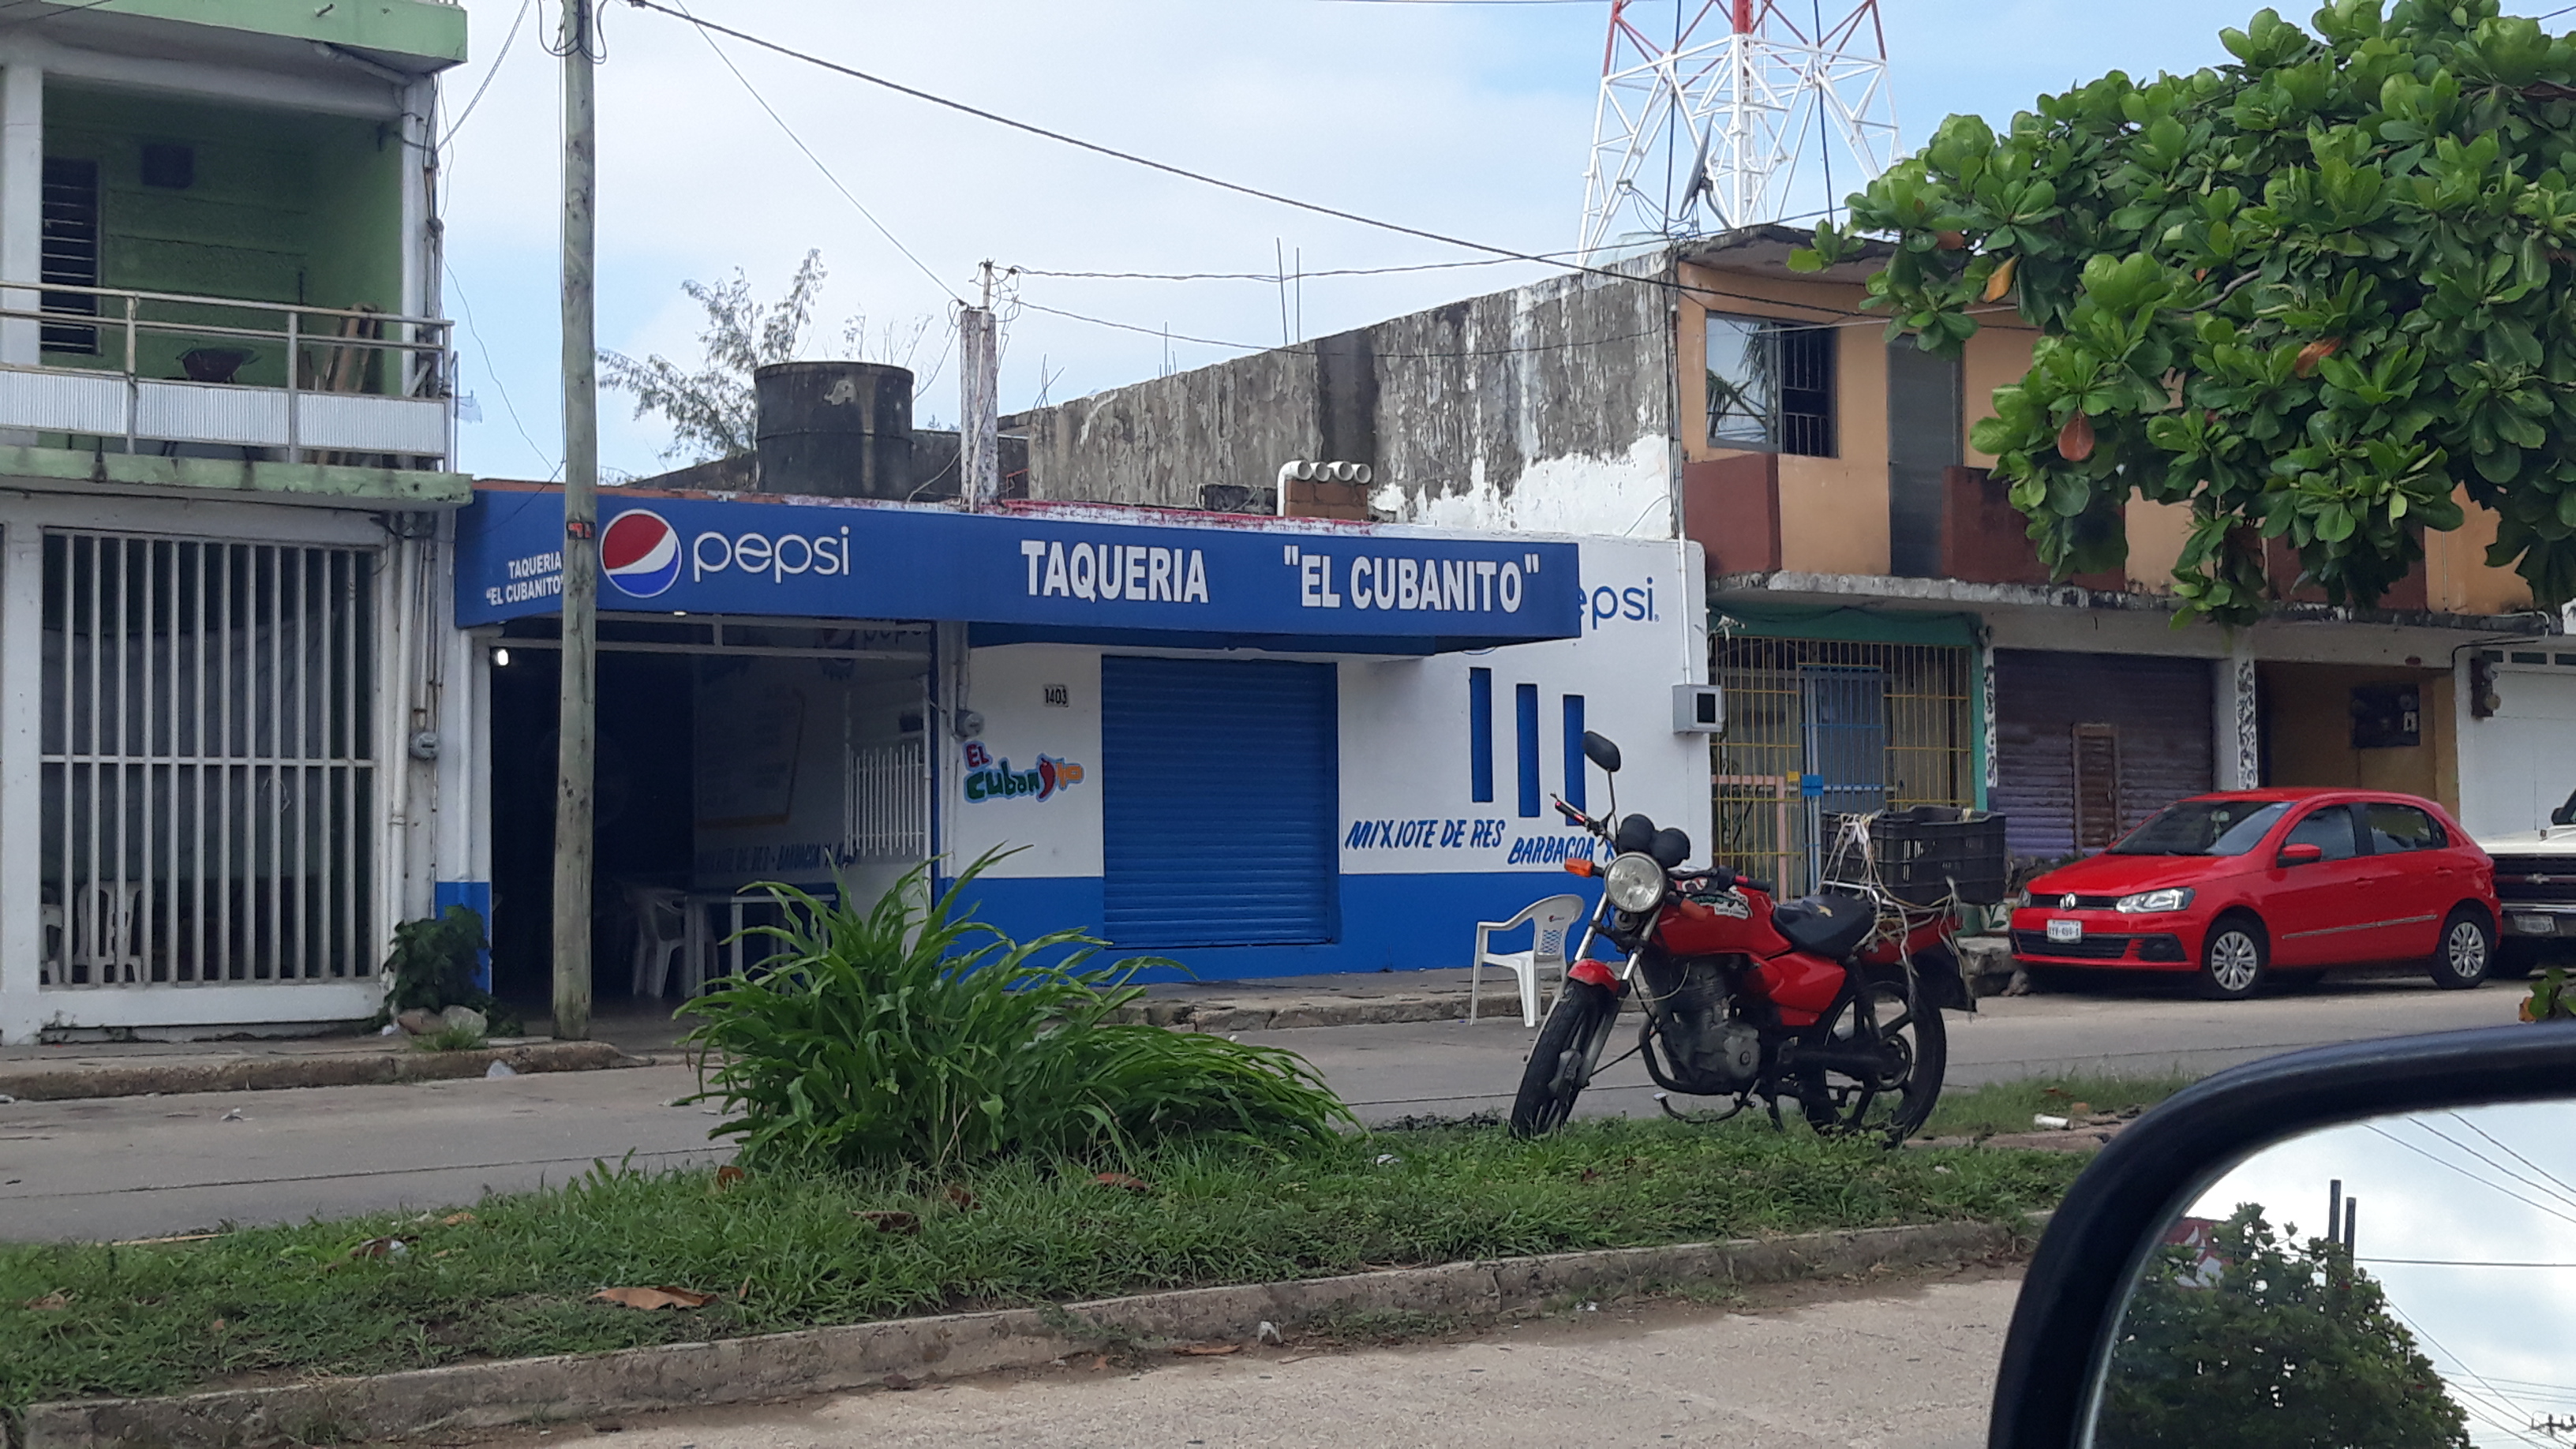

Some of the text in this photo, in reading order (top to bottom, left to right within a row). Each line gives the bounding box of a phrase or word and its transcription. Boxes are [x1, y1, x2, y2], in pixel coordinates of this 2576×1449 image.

[507, 551, 563, 579] TAQUERIA
[693, 526, 851, 584] pepsi
[1021, 540, 1209, 604] TAQUERIA
[1283, 545, 1541, 613] "EL CUBANITO"
[1578, 576, 1653, 631] psi
[1044, 687, 1068, 705] 1403
[965, 743, 990, 768] EL
[1344, 819, 1505, 850] MIXIOTE DE RES
[1507, 836, 1594, 865] BARBACOA
